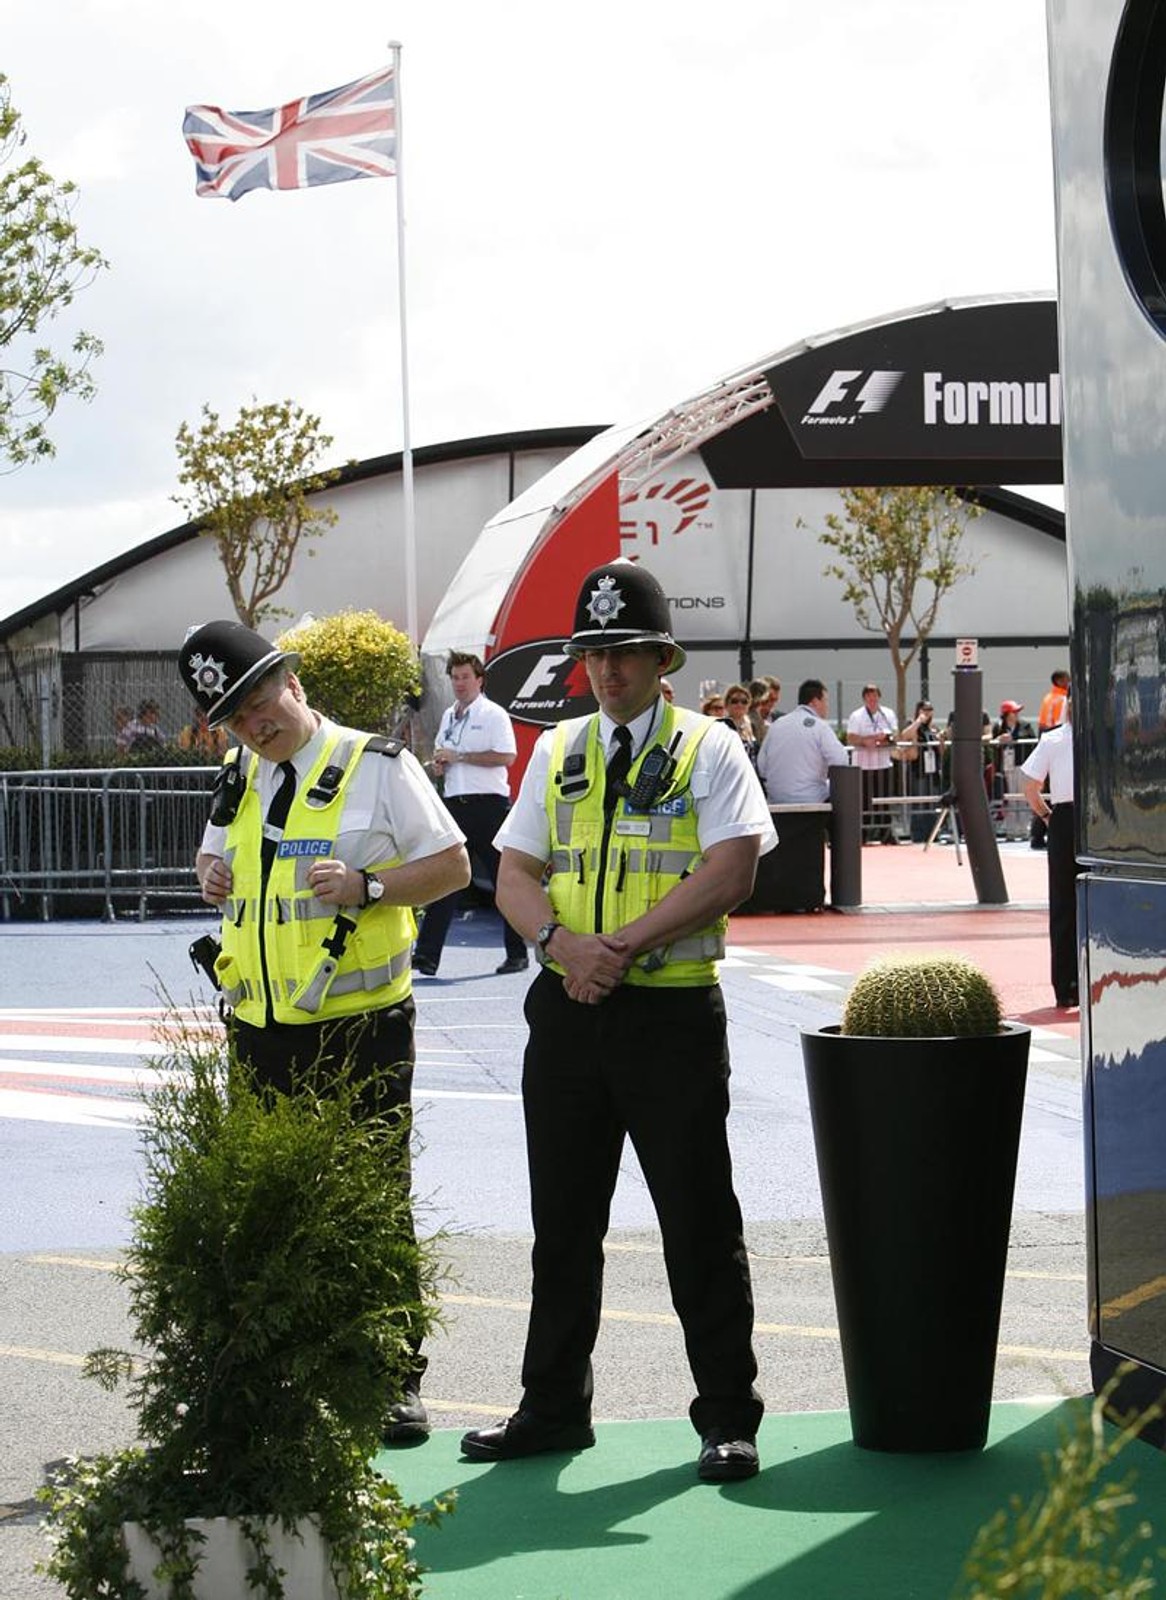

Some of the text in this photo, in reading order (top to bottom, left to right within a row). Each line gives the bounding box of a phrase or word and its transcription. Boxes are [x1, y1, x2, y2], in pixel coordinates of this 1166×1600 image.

[807, 370, 906, 414] F1
[800, 415, 847, 425] Formula
[508, 699, 556, 710] Formula
[279, 841, 330, 856] POLICE
